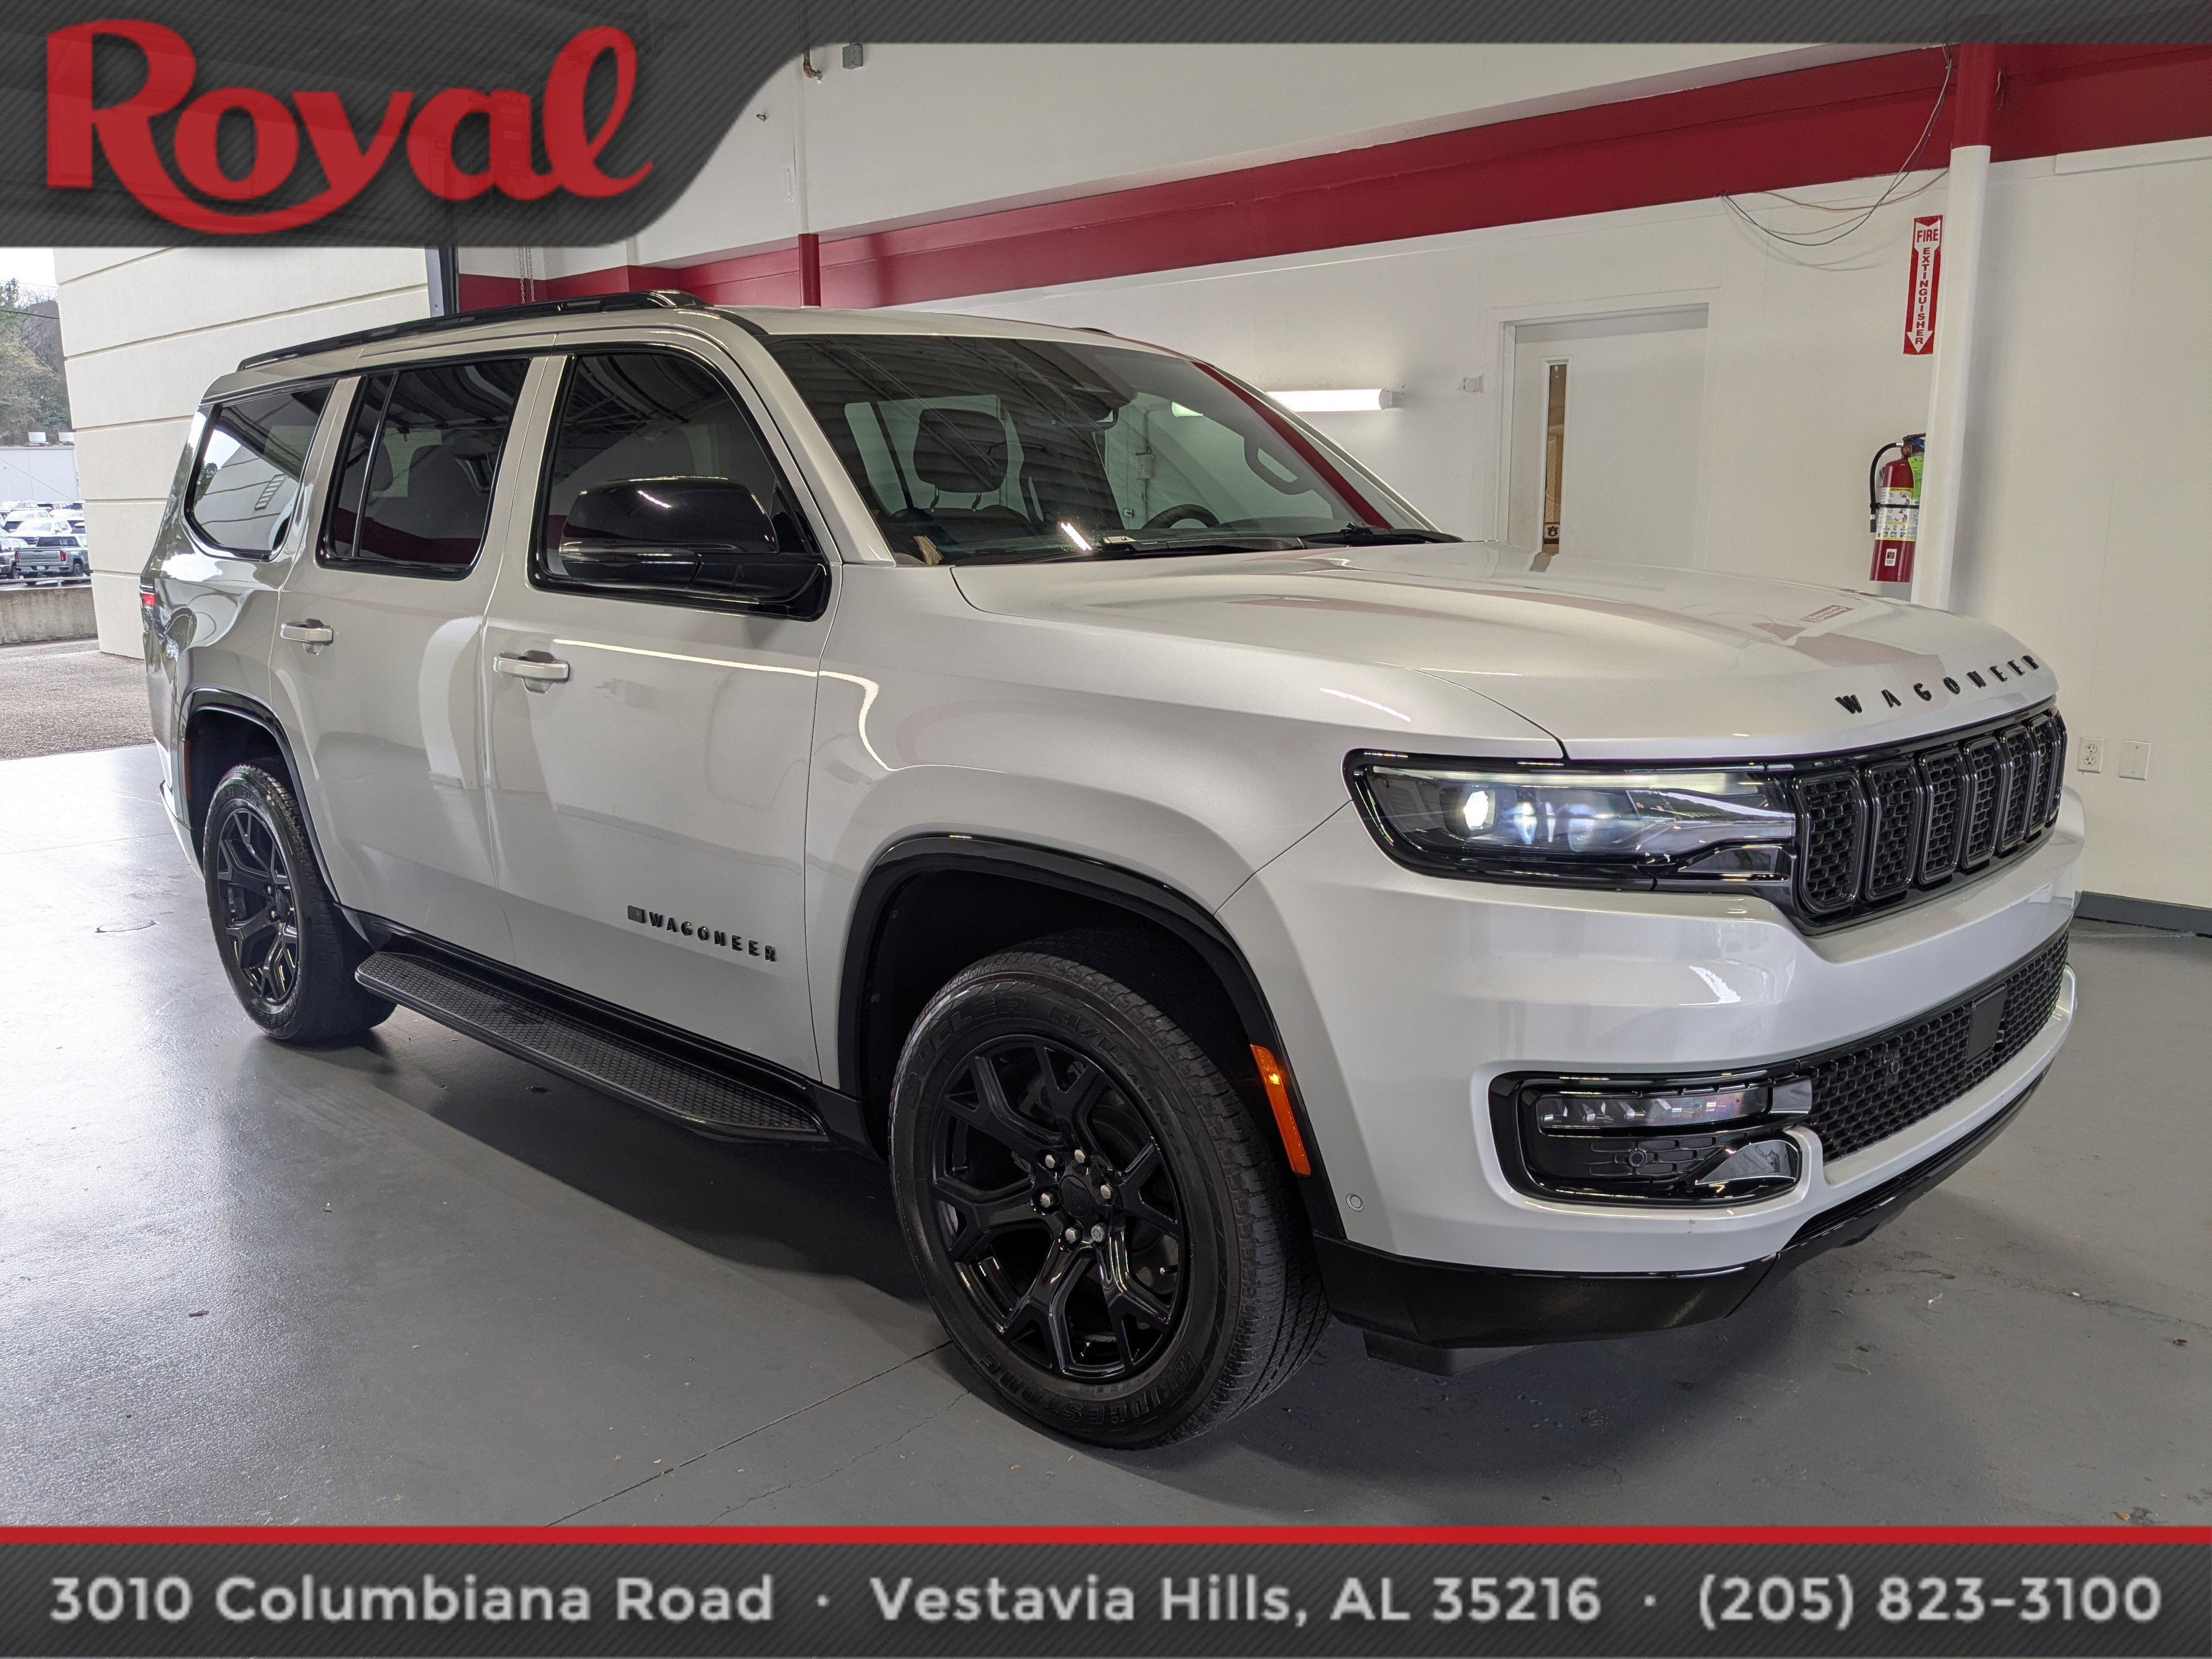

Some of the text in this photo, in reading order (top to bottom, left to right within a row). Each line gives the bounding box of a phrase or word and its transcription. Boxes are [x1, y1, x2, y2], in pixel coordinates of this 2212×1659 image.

[1916, 228, 1939, 243] FIRE
[1915, 247, 1931, 345] EXTINGUISHER
[1835, 654, 2040, 714] WAGONEER
[648, 911, 776, 962] WAGONEER
